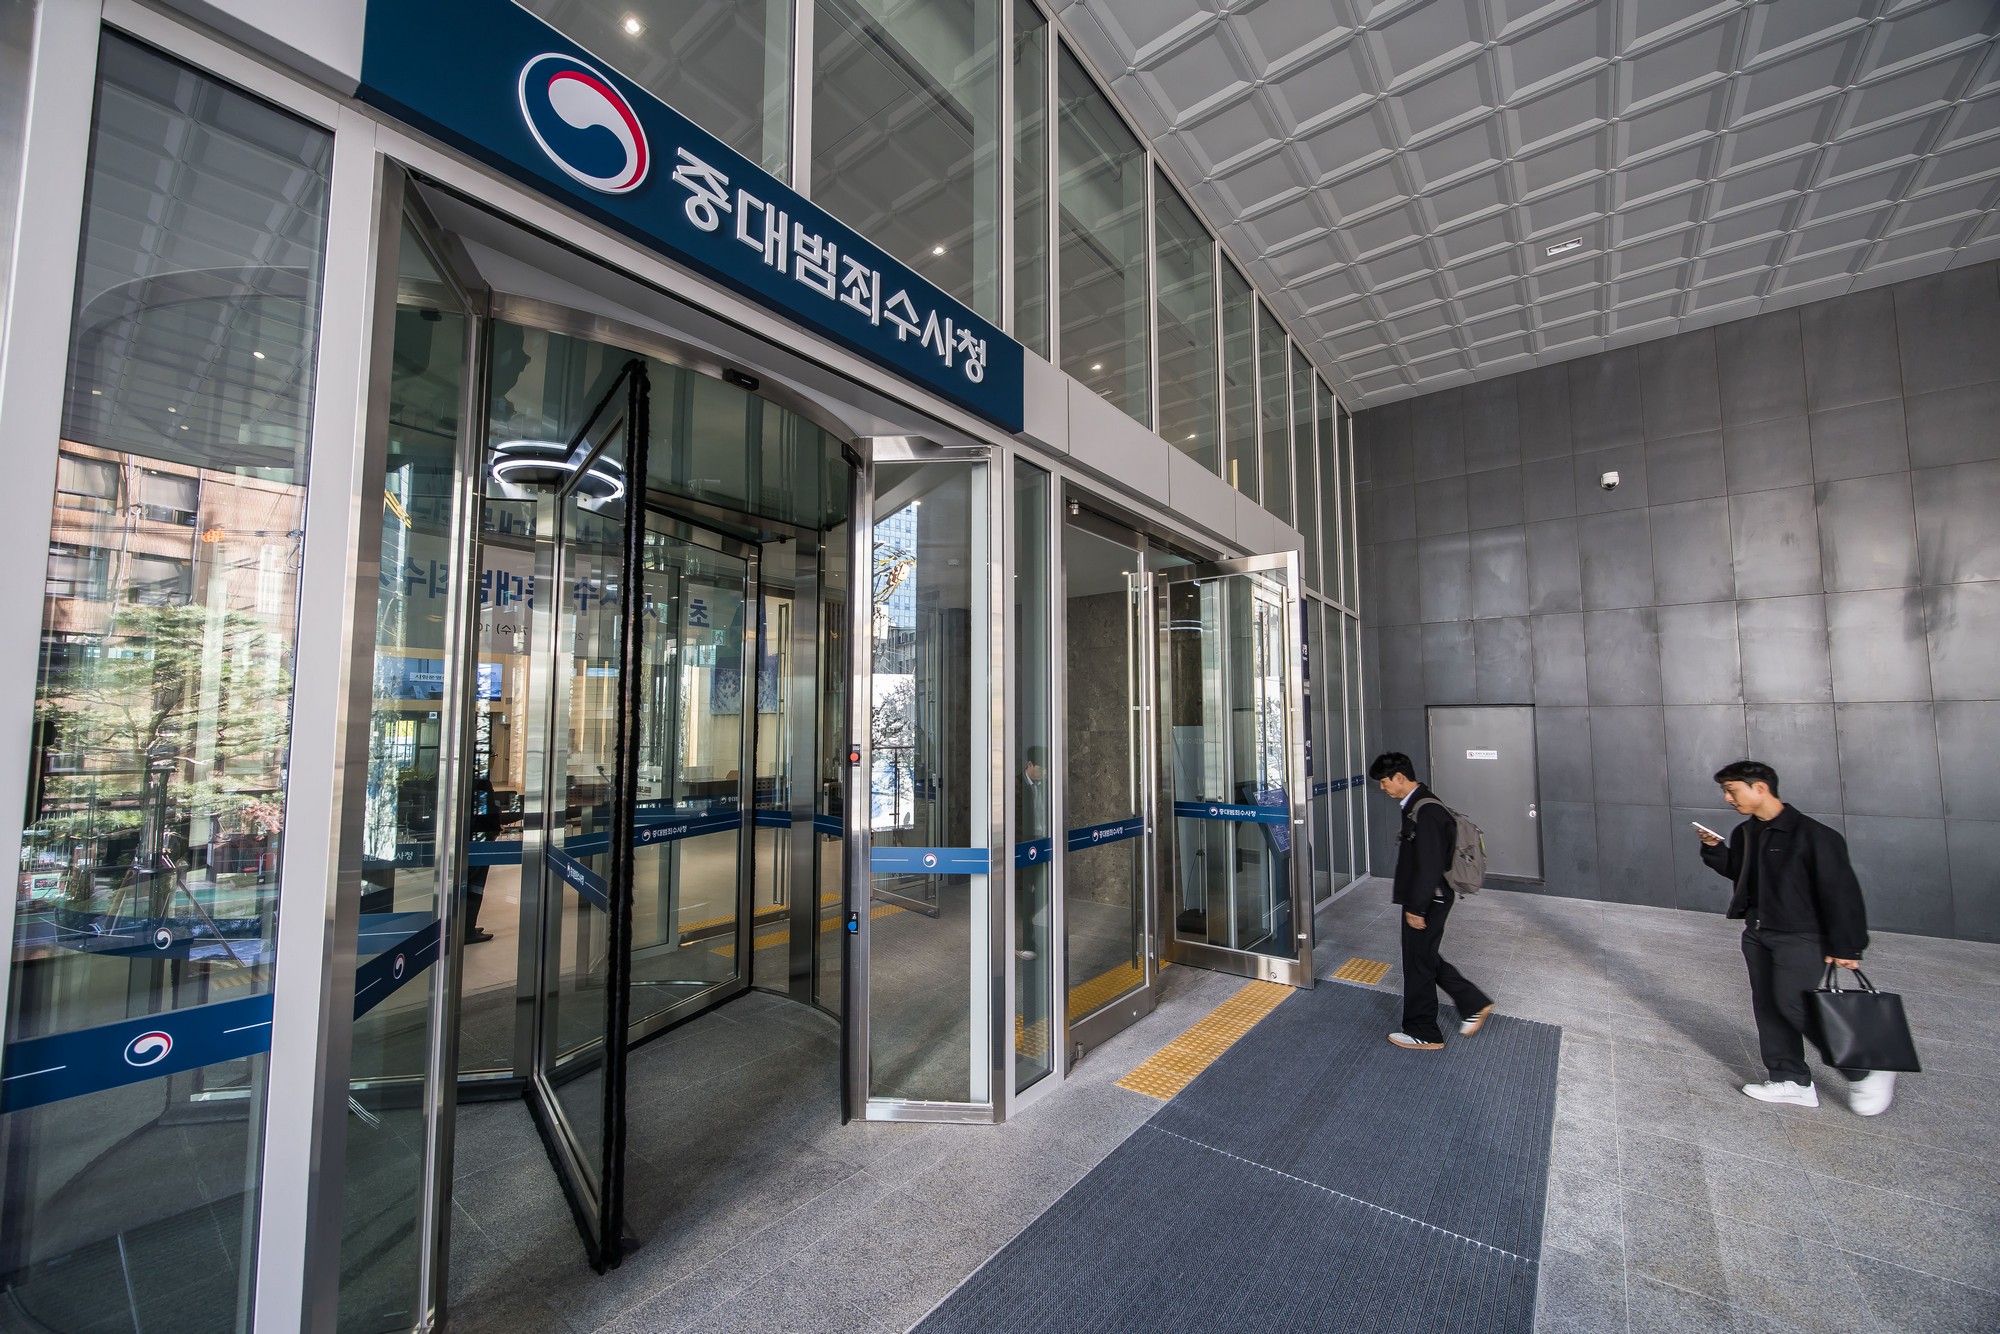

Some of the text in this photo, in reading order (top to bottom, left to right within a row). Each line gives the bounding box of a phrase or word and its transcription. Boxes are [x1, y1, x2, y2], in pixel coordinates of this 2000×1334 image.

[672, 146, 987, 383] 중대범죄수사청
[1219, 808, 1256, 818] 중대범죄수사청
[652, 825, 687, 838] 중대범죄수사청
